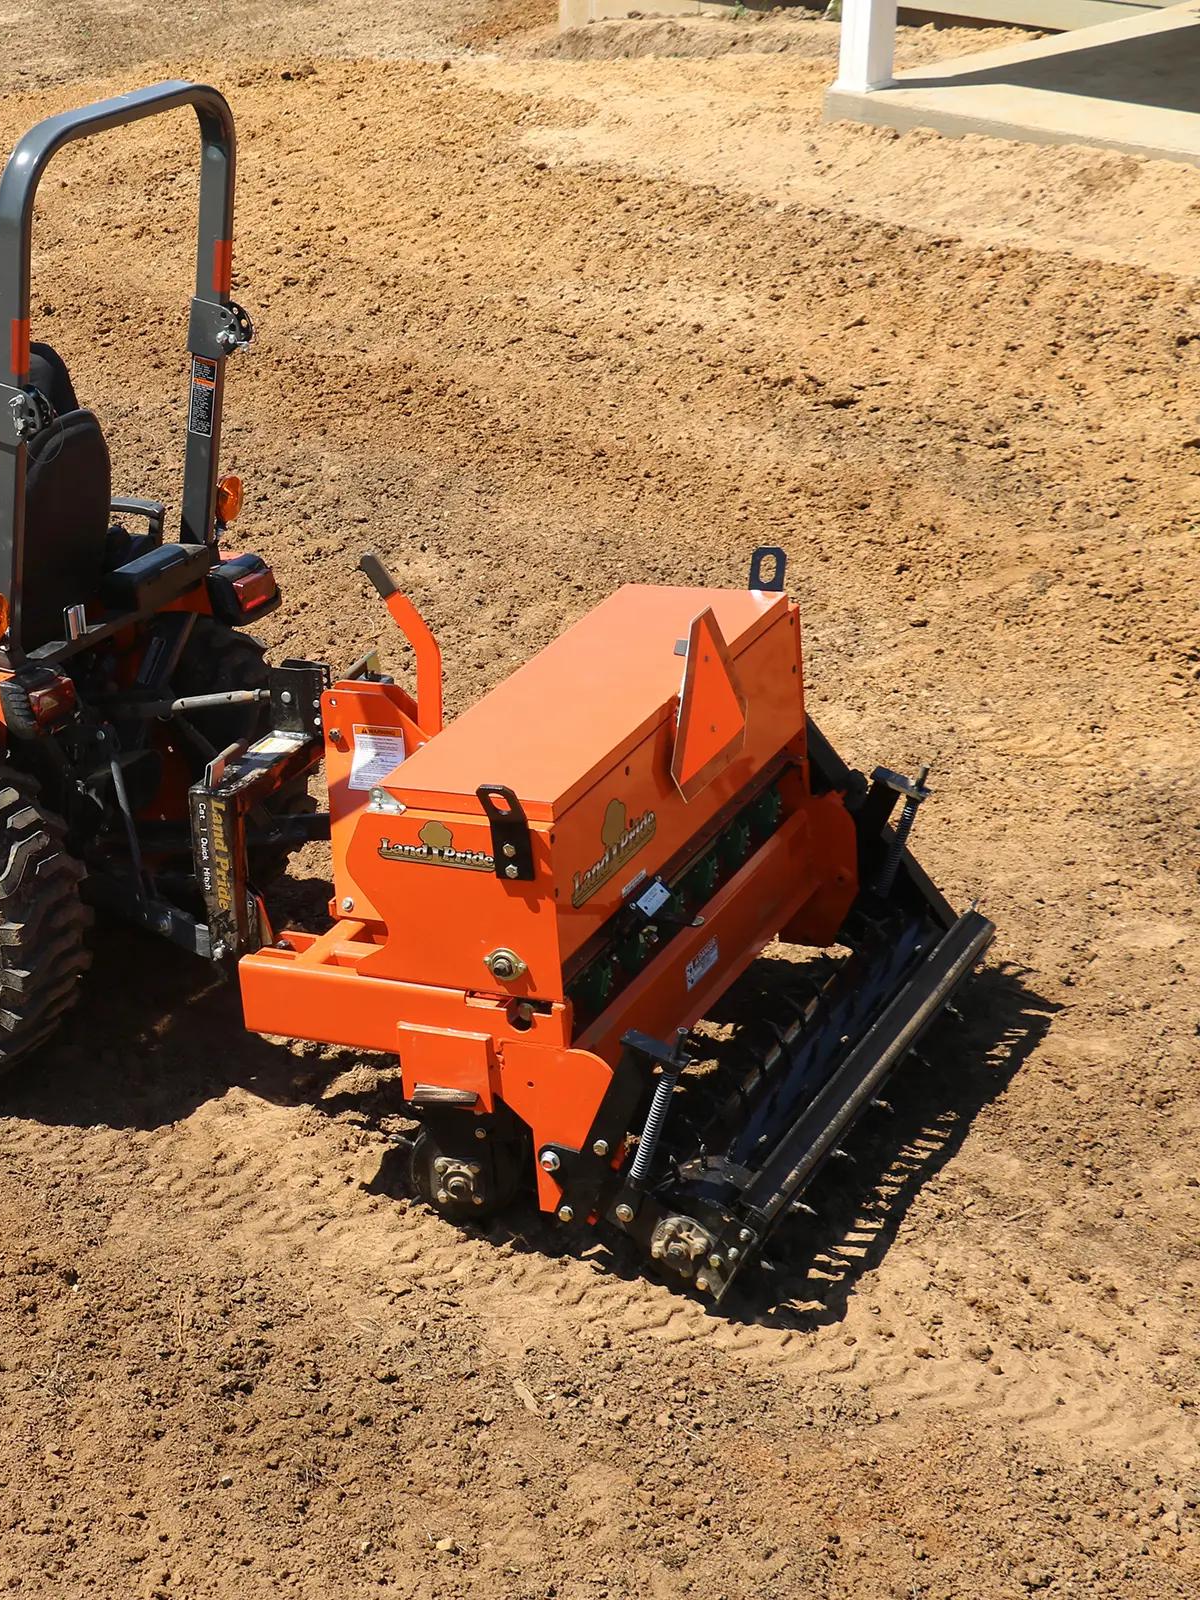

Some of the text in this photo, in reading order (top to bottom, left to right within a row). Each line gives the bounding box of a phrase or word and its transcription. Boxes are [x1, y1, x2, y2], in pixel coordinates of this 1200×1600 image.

[200, 837, 210, 861] Quick
[211, 800, 232, 910] Land Pride
[379, 837, 496, 867] Land Pride
